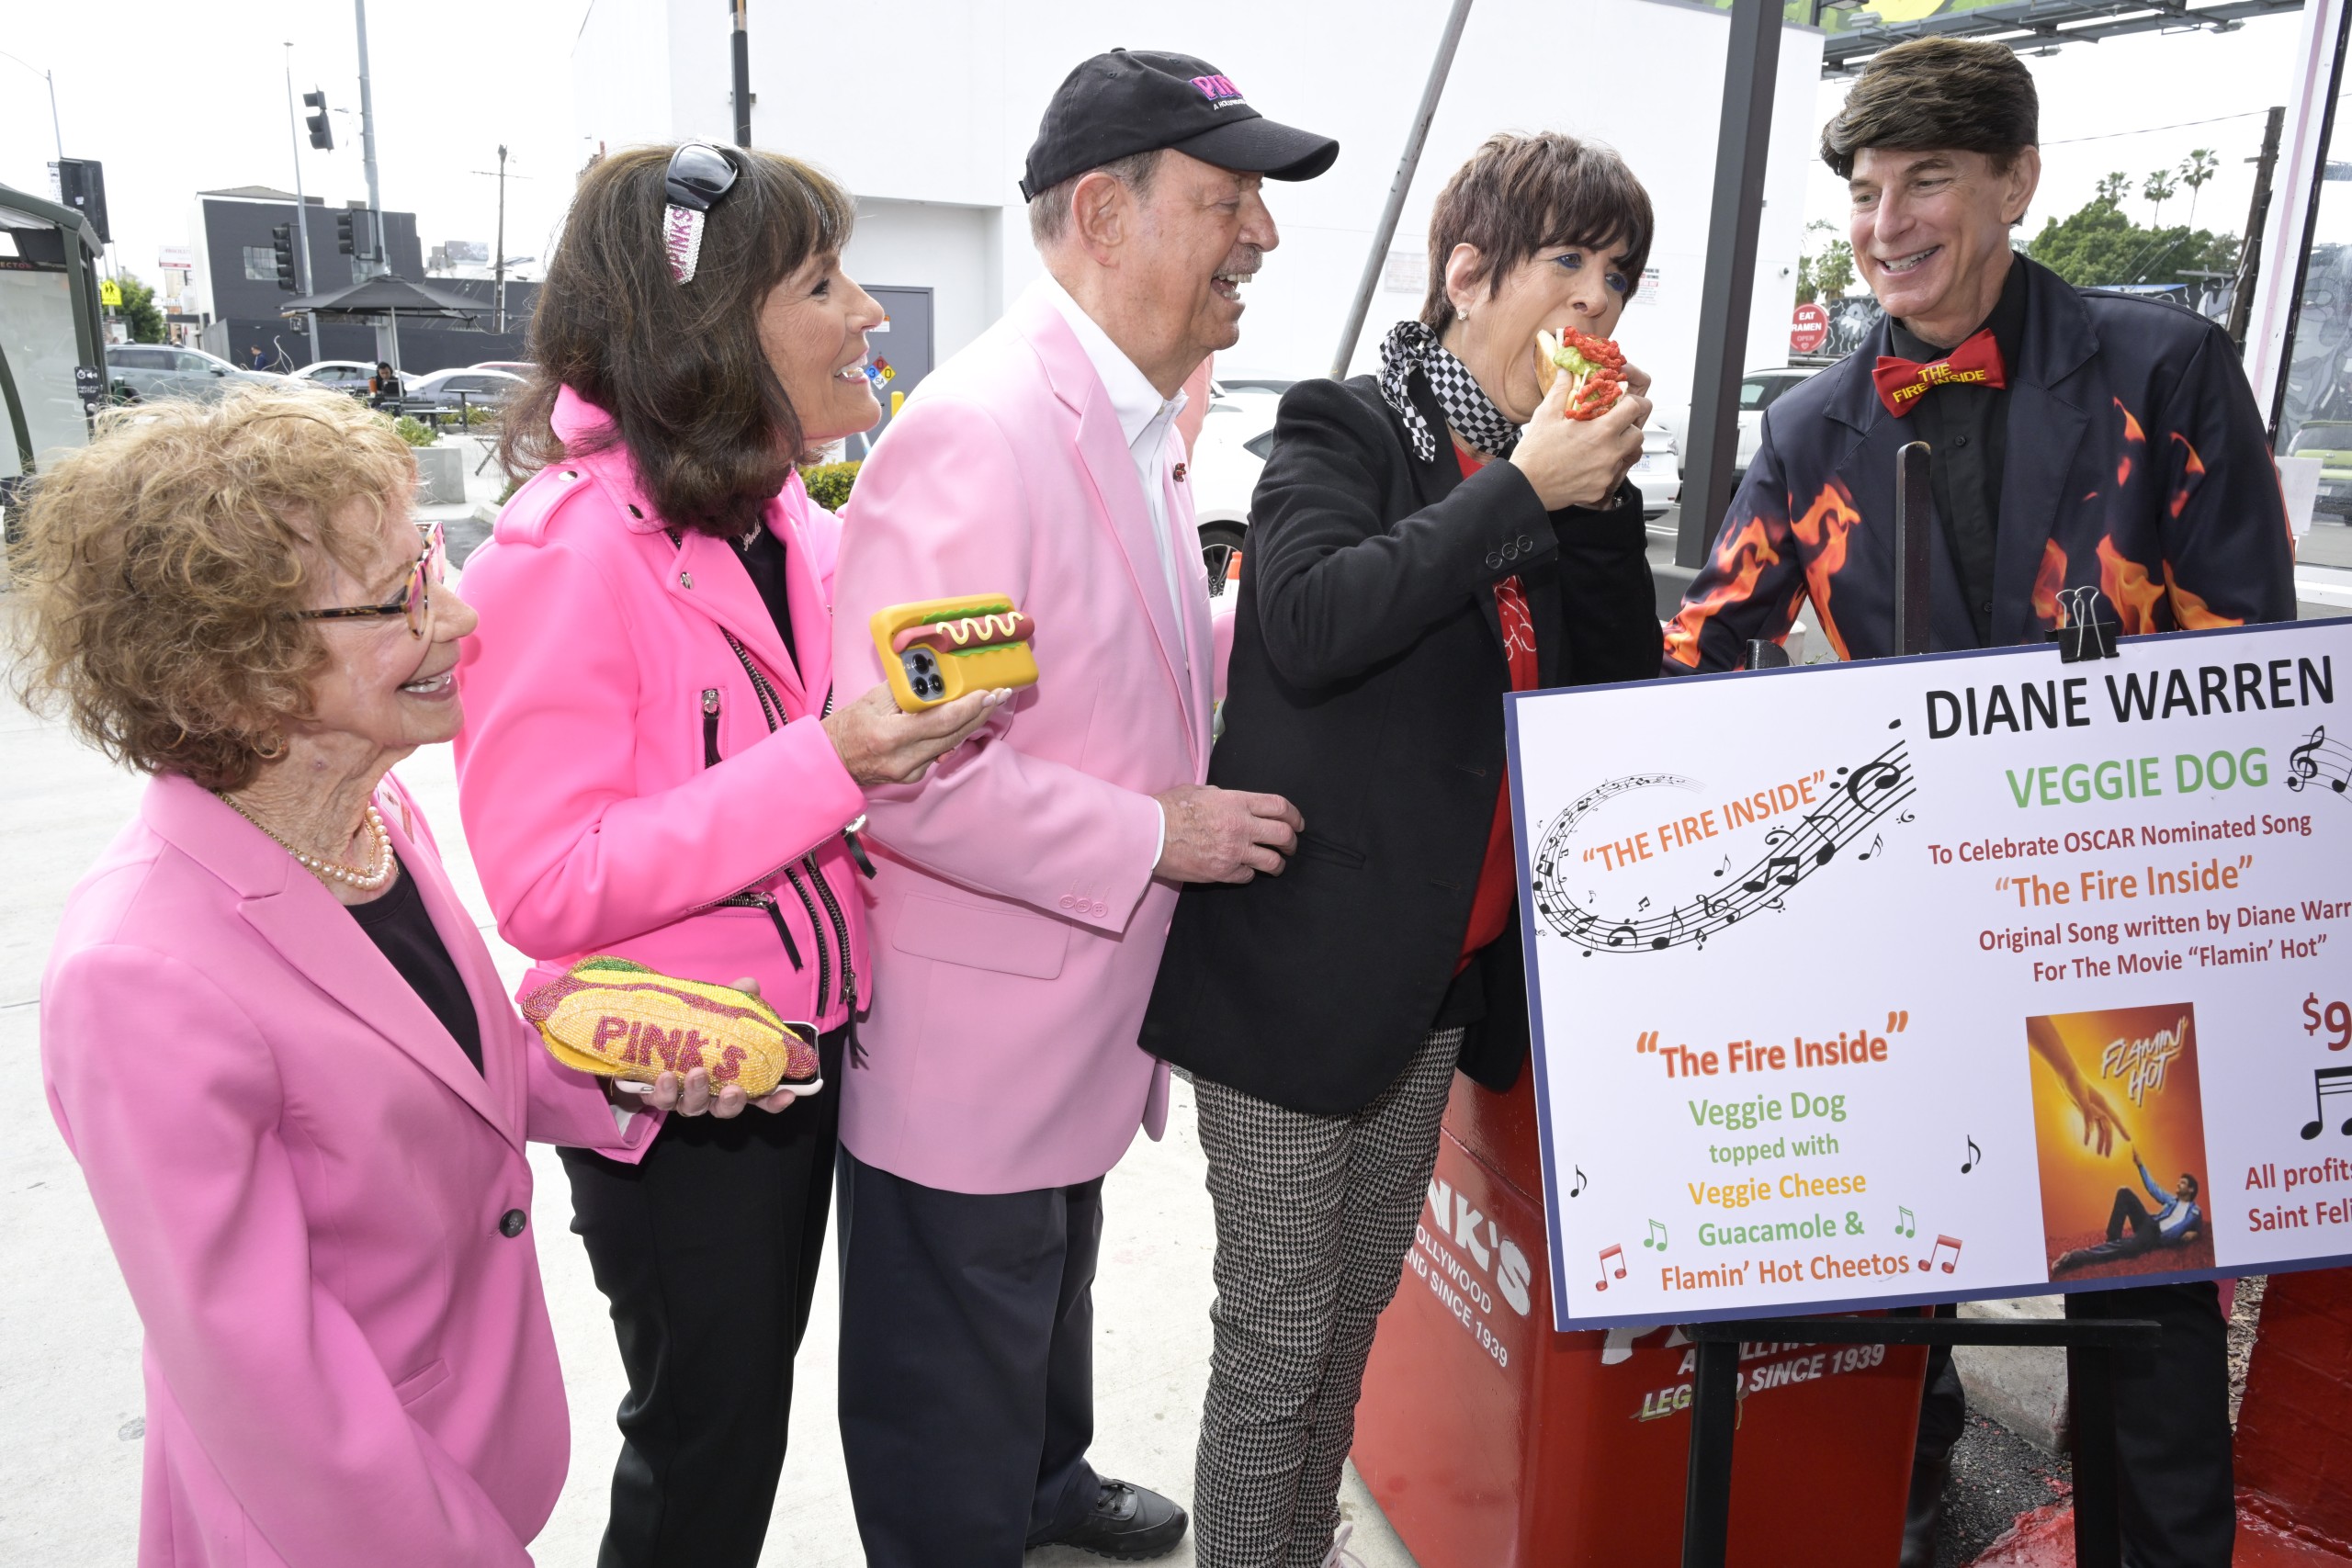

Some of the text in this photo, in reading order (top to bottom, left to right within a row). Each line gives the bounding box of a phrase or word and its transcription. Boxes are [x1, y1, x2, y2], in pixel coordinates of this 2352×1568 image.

[1792, 323, 1822, 332] RAMEN
[1799, 311, 1815, 321] EAT
[868, 367, 891, 378] 3 0
[1893, 369, 1986, 403] FIRE INSIDE
[1918, 364, 1951, 382] THE
[1926, 655, 2334, 739] DIANE WARREN
[2006, 748, 2268, 808] VEGGIE DOG
[1583, 770, 1825, 871] “THE FIRE INSIDE”
[1928, 815, 2312, 864] To Celebrate OSCAR Nominated Song
[1996, 855, 2252, 907] “The Fire Inside”
[1980, 900, 2351, 953] Original Song written by Diane Warr
[2034, 934, 2326, 982] For The Movie “Flamin’ Hot”
[1636, 1010, 1908, 1078] “The Fire Inside”
[2302, 992, 2352, 1051] $9
[592, 1015, 748, 1081] PINK'S
[2129, 1052, 2180, 1108] HOT
[1689, 1092, 1847, 1130] Veggie Dog
[1709, 1134, 1838, 1167] topped with
[2245, 1157, 2352, 1192] All profit
[1688, 1173, 1865, 1208] Veggie Cheese
[1699, 1212, 1864, 1246] Guacamole &
[2248, 1205, 2309, 1232] Saint
[1415, 1224, 1492, 1314] OLLYWOOD
[1425, 1177, 1531, 1316] NK'S
[1662, 1254, 1909, 1291] Flamin’ Hot Cheetos
[1430, 1271, 1472, 1328] SINCE
[1476, 1320, 1508, 1368] 1939
[1677, 1348, 1696, 1375] A
[1749, 1354, 1826, 1392] SINCE
[1832, 1344, 1885, 1375] 1939
